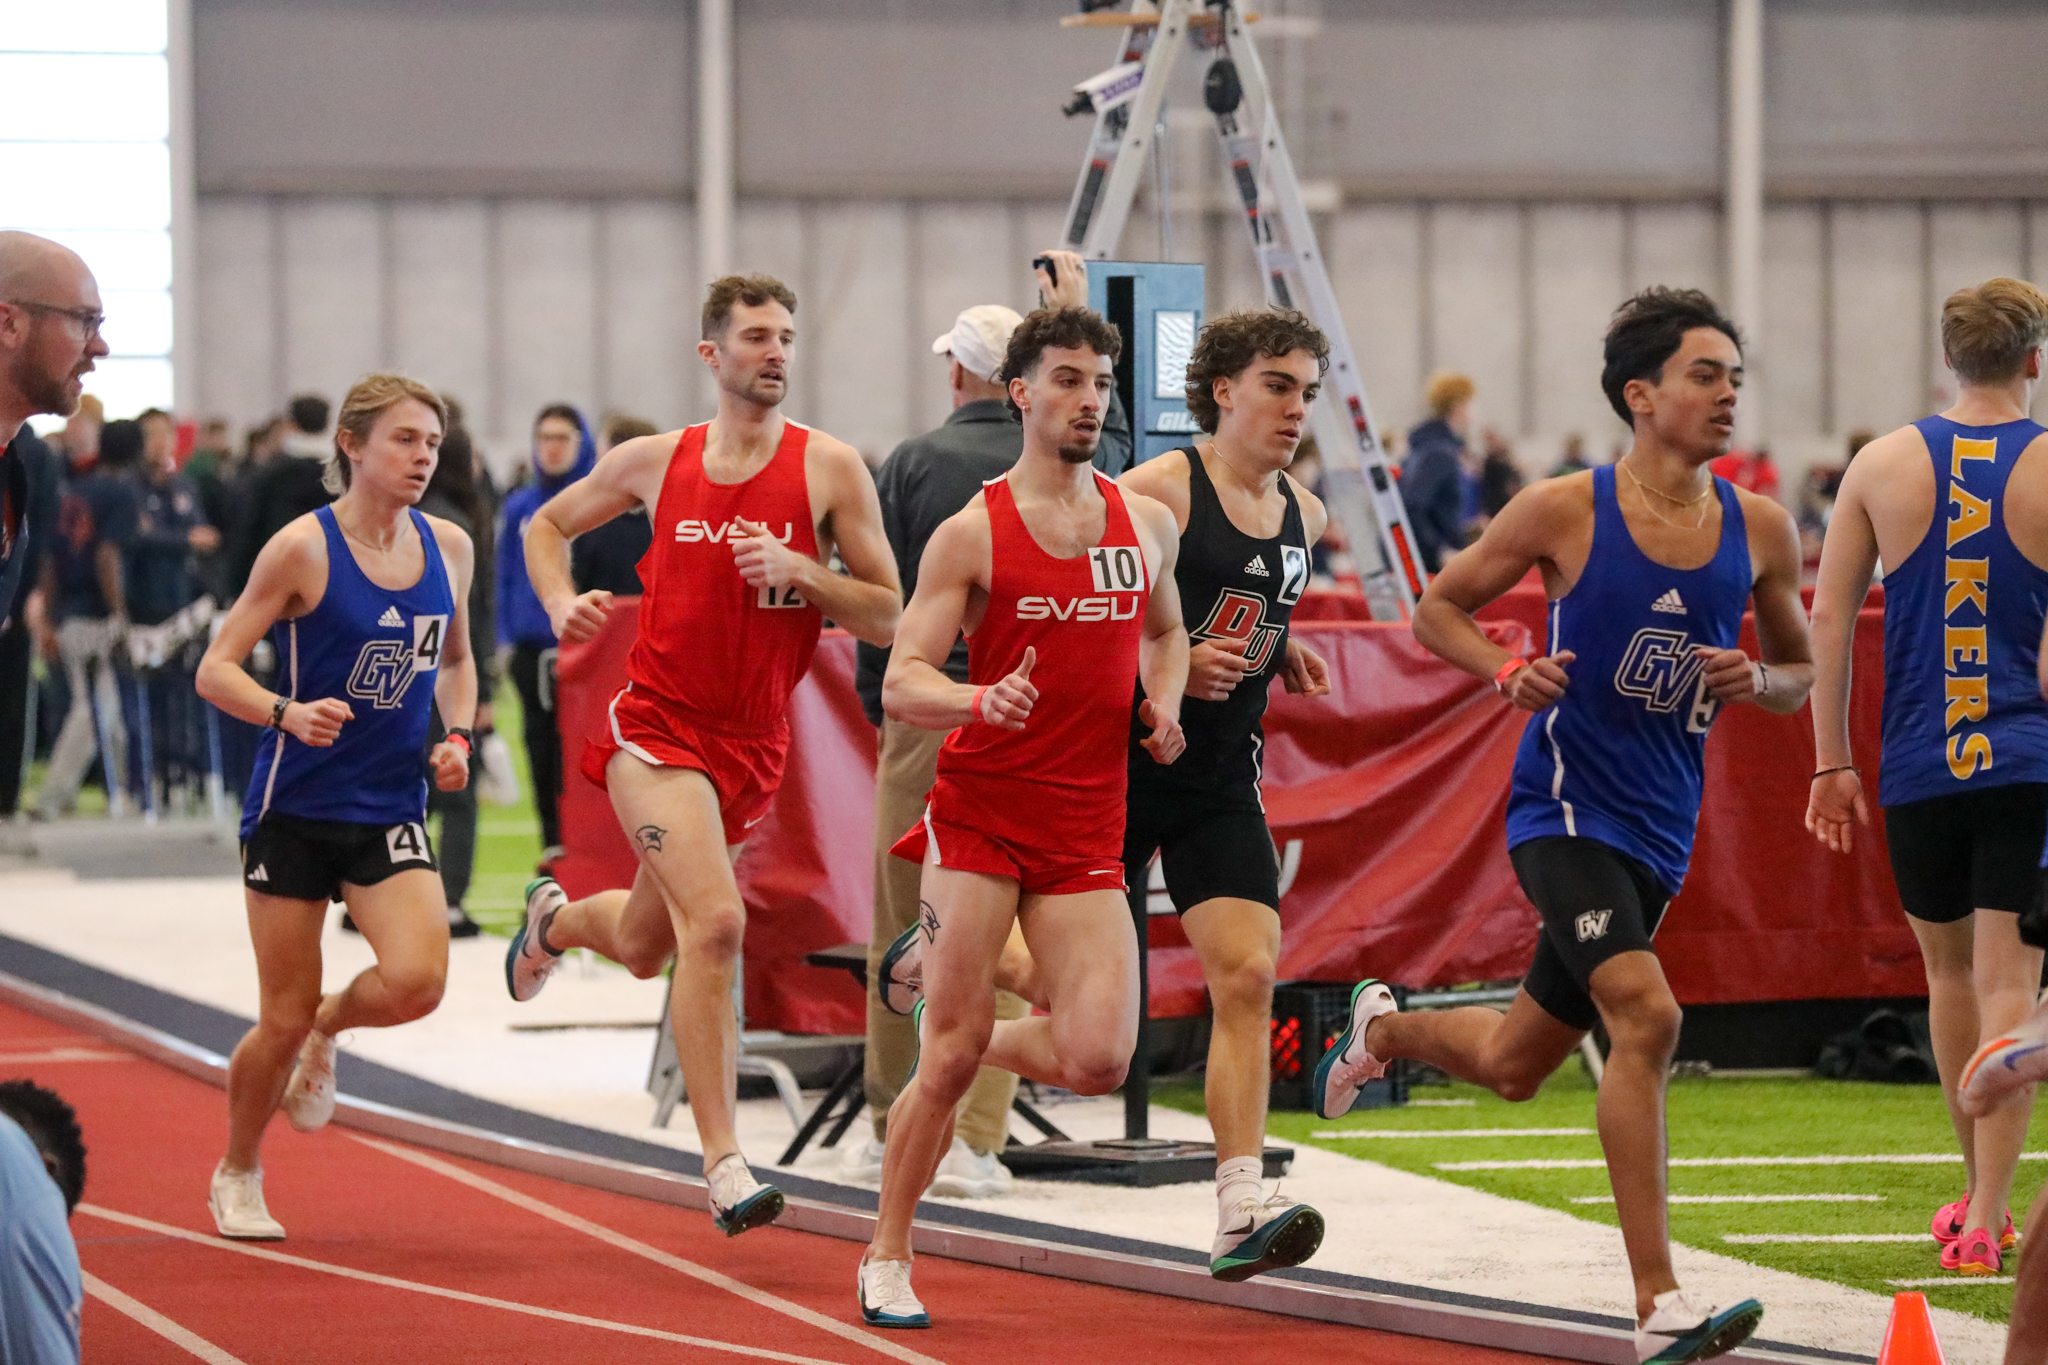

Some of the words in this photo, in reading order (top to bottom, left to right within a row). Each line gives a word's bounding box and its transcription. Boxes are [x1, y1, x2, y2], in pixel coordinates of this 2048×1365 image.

[1093, 548, 1137, 589] 10
[1244, 566, 1270, 577] adidas
[1282, 550, 1304, 602] 2
[378, 618, 406, 628] adidas
[1016, 596, 1139, 622] SVSU
[1651, 603, 1688, 615] adidas
[1945, 433, 1998, 780] LAKERS
[417, 619, 441, 666] 4
[346, 640, 418, 710] GV
[1614, 627, 1710, 714] GV
[394, 823, 422, 856] 4
[1574, 909, 1613, 942] GV
